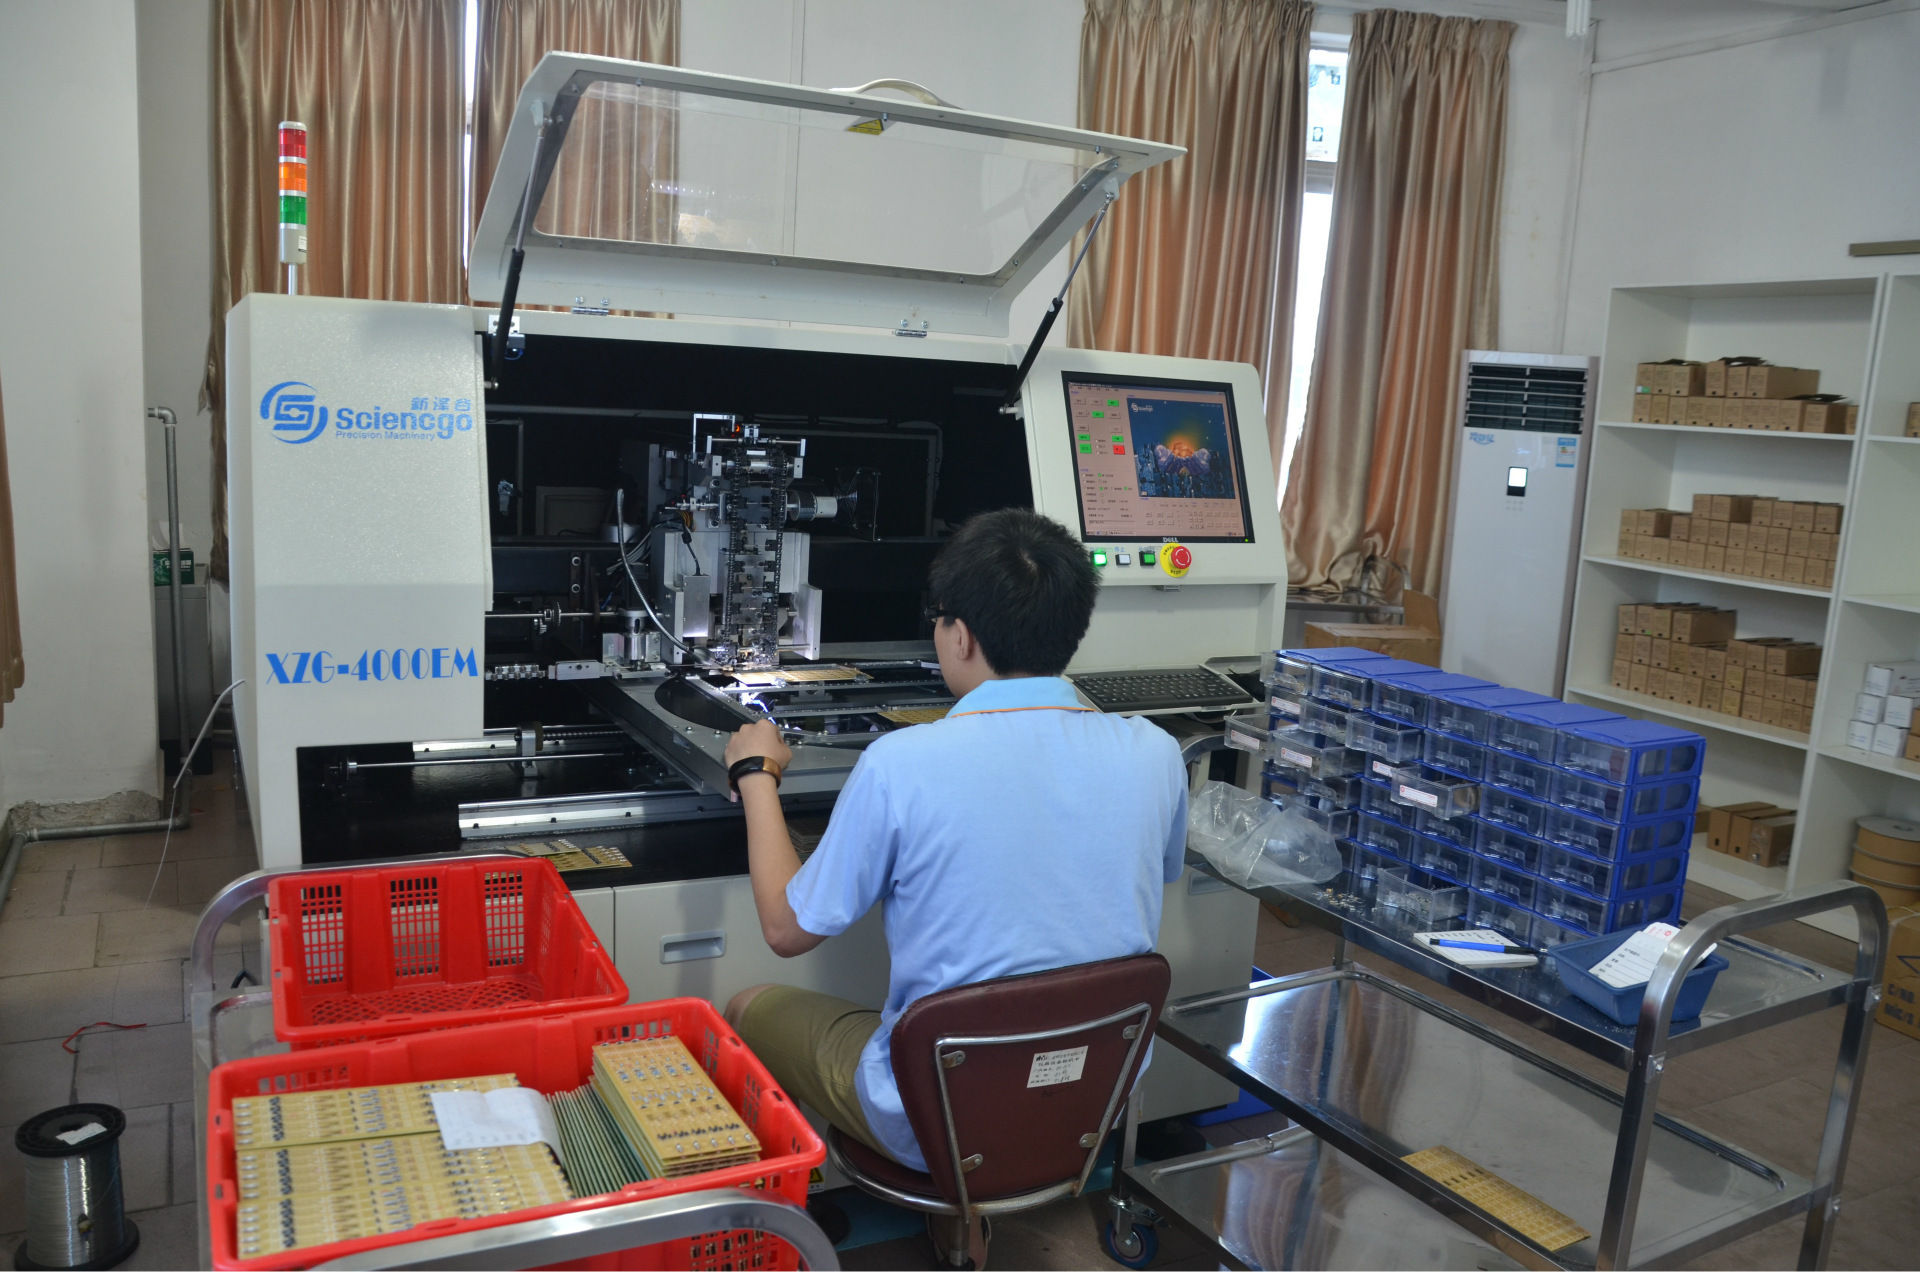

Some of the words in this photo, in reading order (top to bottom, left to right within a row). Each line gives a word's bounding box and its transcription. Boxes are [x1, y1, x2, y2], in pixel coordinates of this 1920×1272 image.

[411, 396, 471, 412] 新泽谷
[336, 405, 473, 440] Sciencgo
[336, 430, 383, 440] Precision
[384, 431, 435, 441] Machinery
[265, 647, 479, 685] XZG-4000EM
